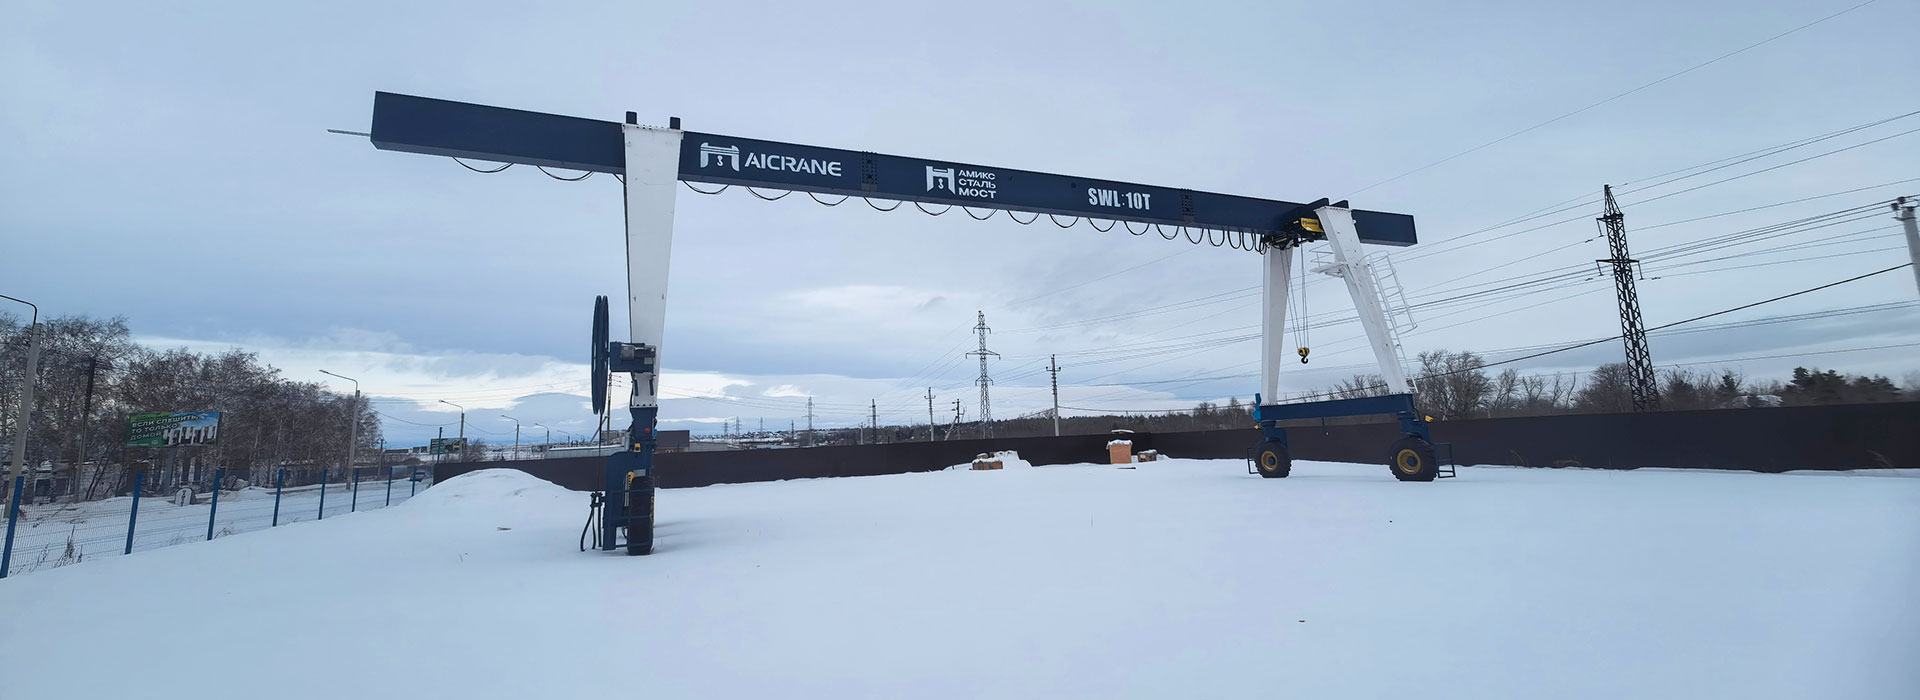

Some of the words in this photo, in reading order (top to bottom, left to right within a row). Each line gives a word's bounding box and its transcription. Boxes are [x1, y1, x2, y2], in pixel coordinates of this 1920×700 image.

[744, 152, 842, 177] AICRANE
[958, 169, 996, 180] АМИКС
[958, 178, 997, 189] СТАЛЬ
[958, 187, 997, 199] МОСТ
[132, 420, 154, 428] ЕСЛИ
[145, 423, 178, 432] ТОЛЬКО
[130, 431, 162, 440] ДОМОЙ
